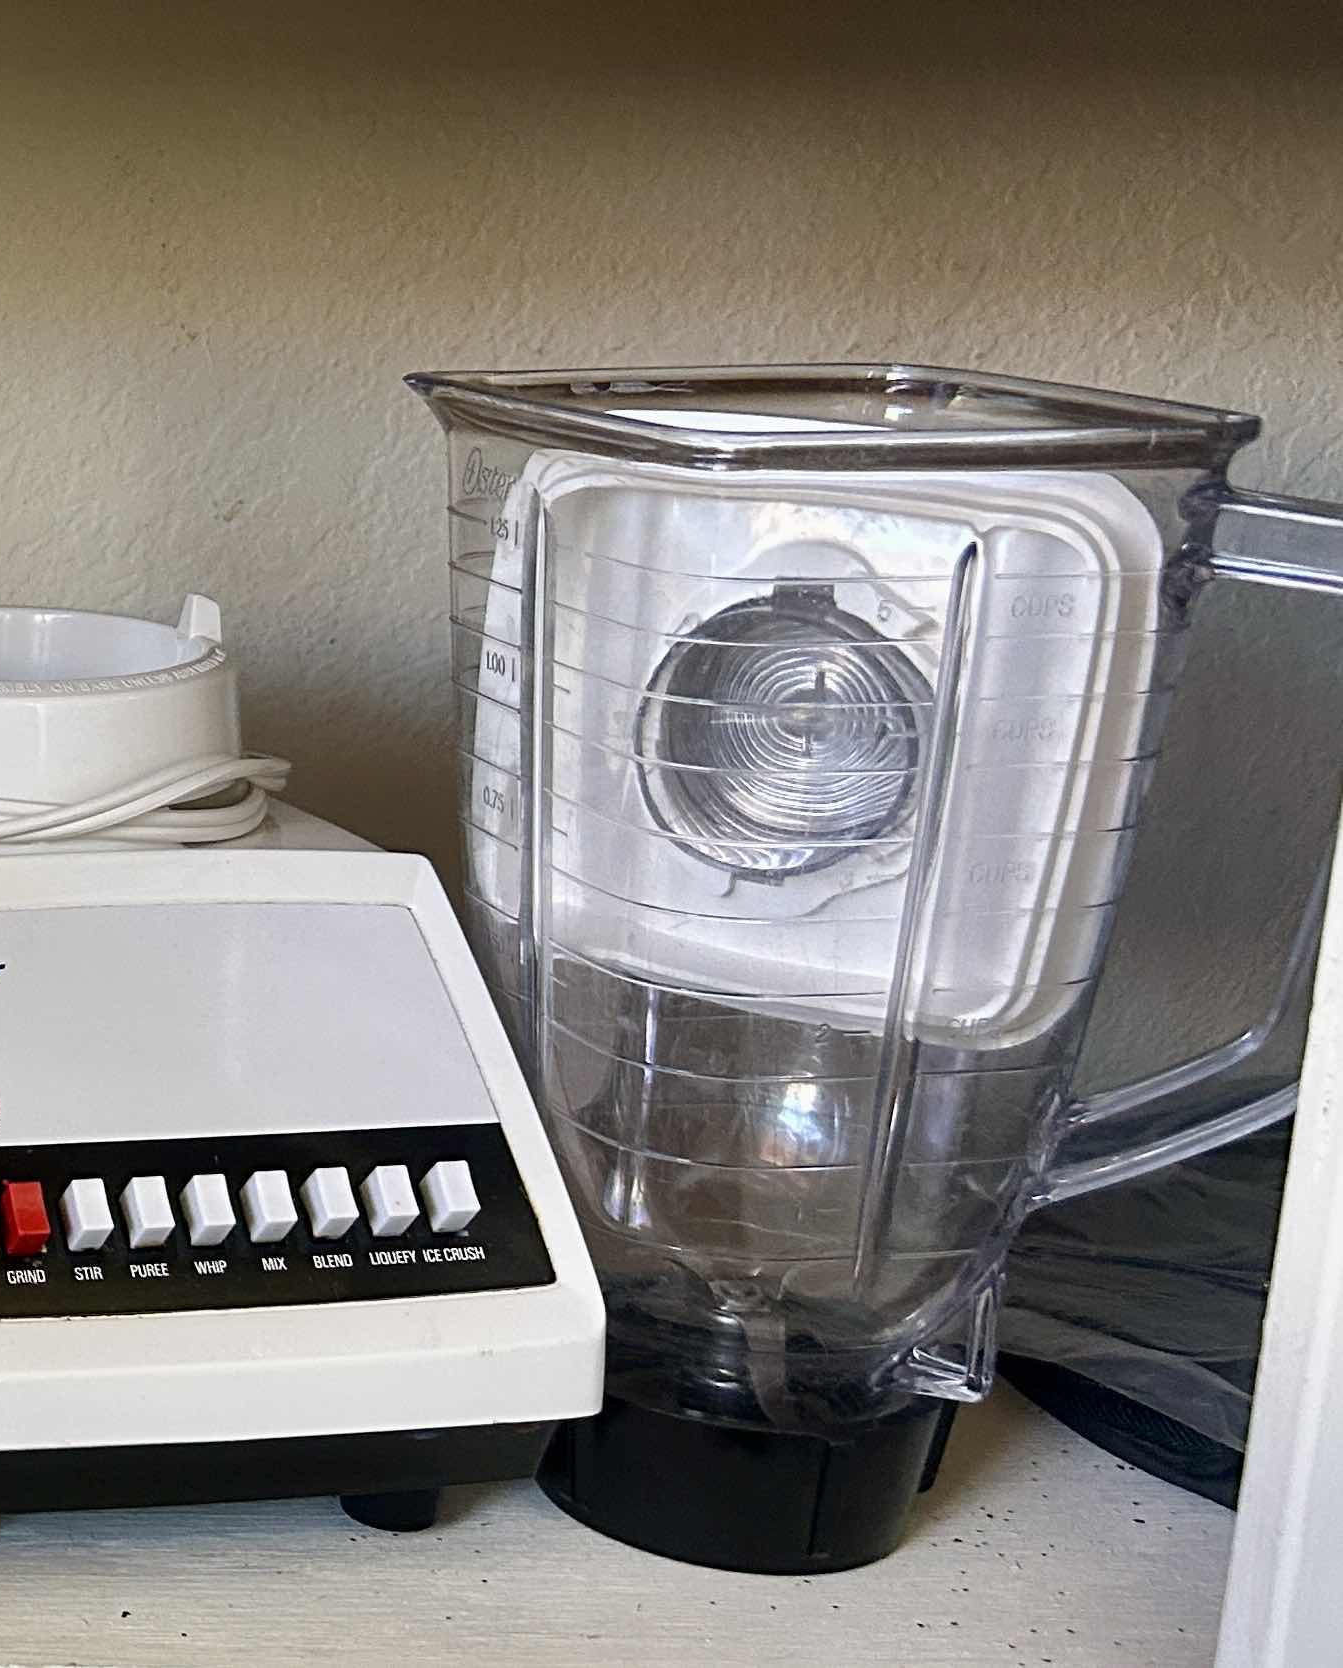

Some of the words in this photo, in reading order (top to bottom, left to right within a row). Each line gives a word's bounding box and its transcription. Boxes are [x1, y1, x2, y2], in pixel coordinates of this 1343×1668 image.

[313, 1254, 353, 1270] BLEND
[368, 1250, 416, 1266] LIQUEFY
[422, 1249, 442, 1263] ICE
[443, 1247, 486, 1262] CRUSH
[129, 1263, 170, 1278] PUREE
[194, 1260, 227, 1275] WHIP
[262, 1257, 288, 1272] MIX
[6, 1269, 47, 1285] GRIND
[74, 1266, 104, 1281] STIR
